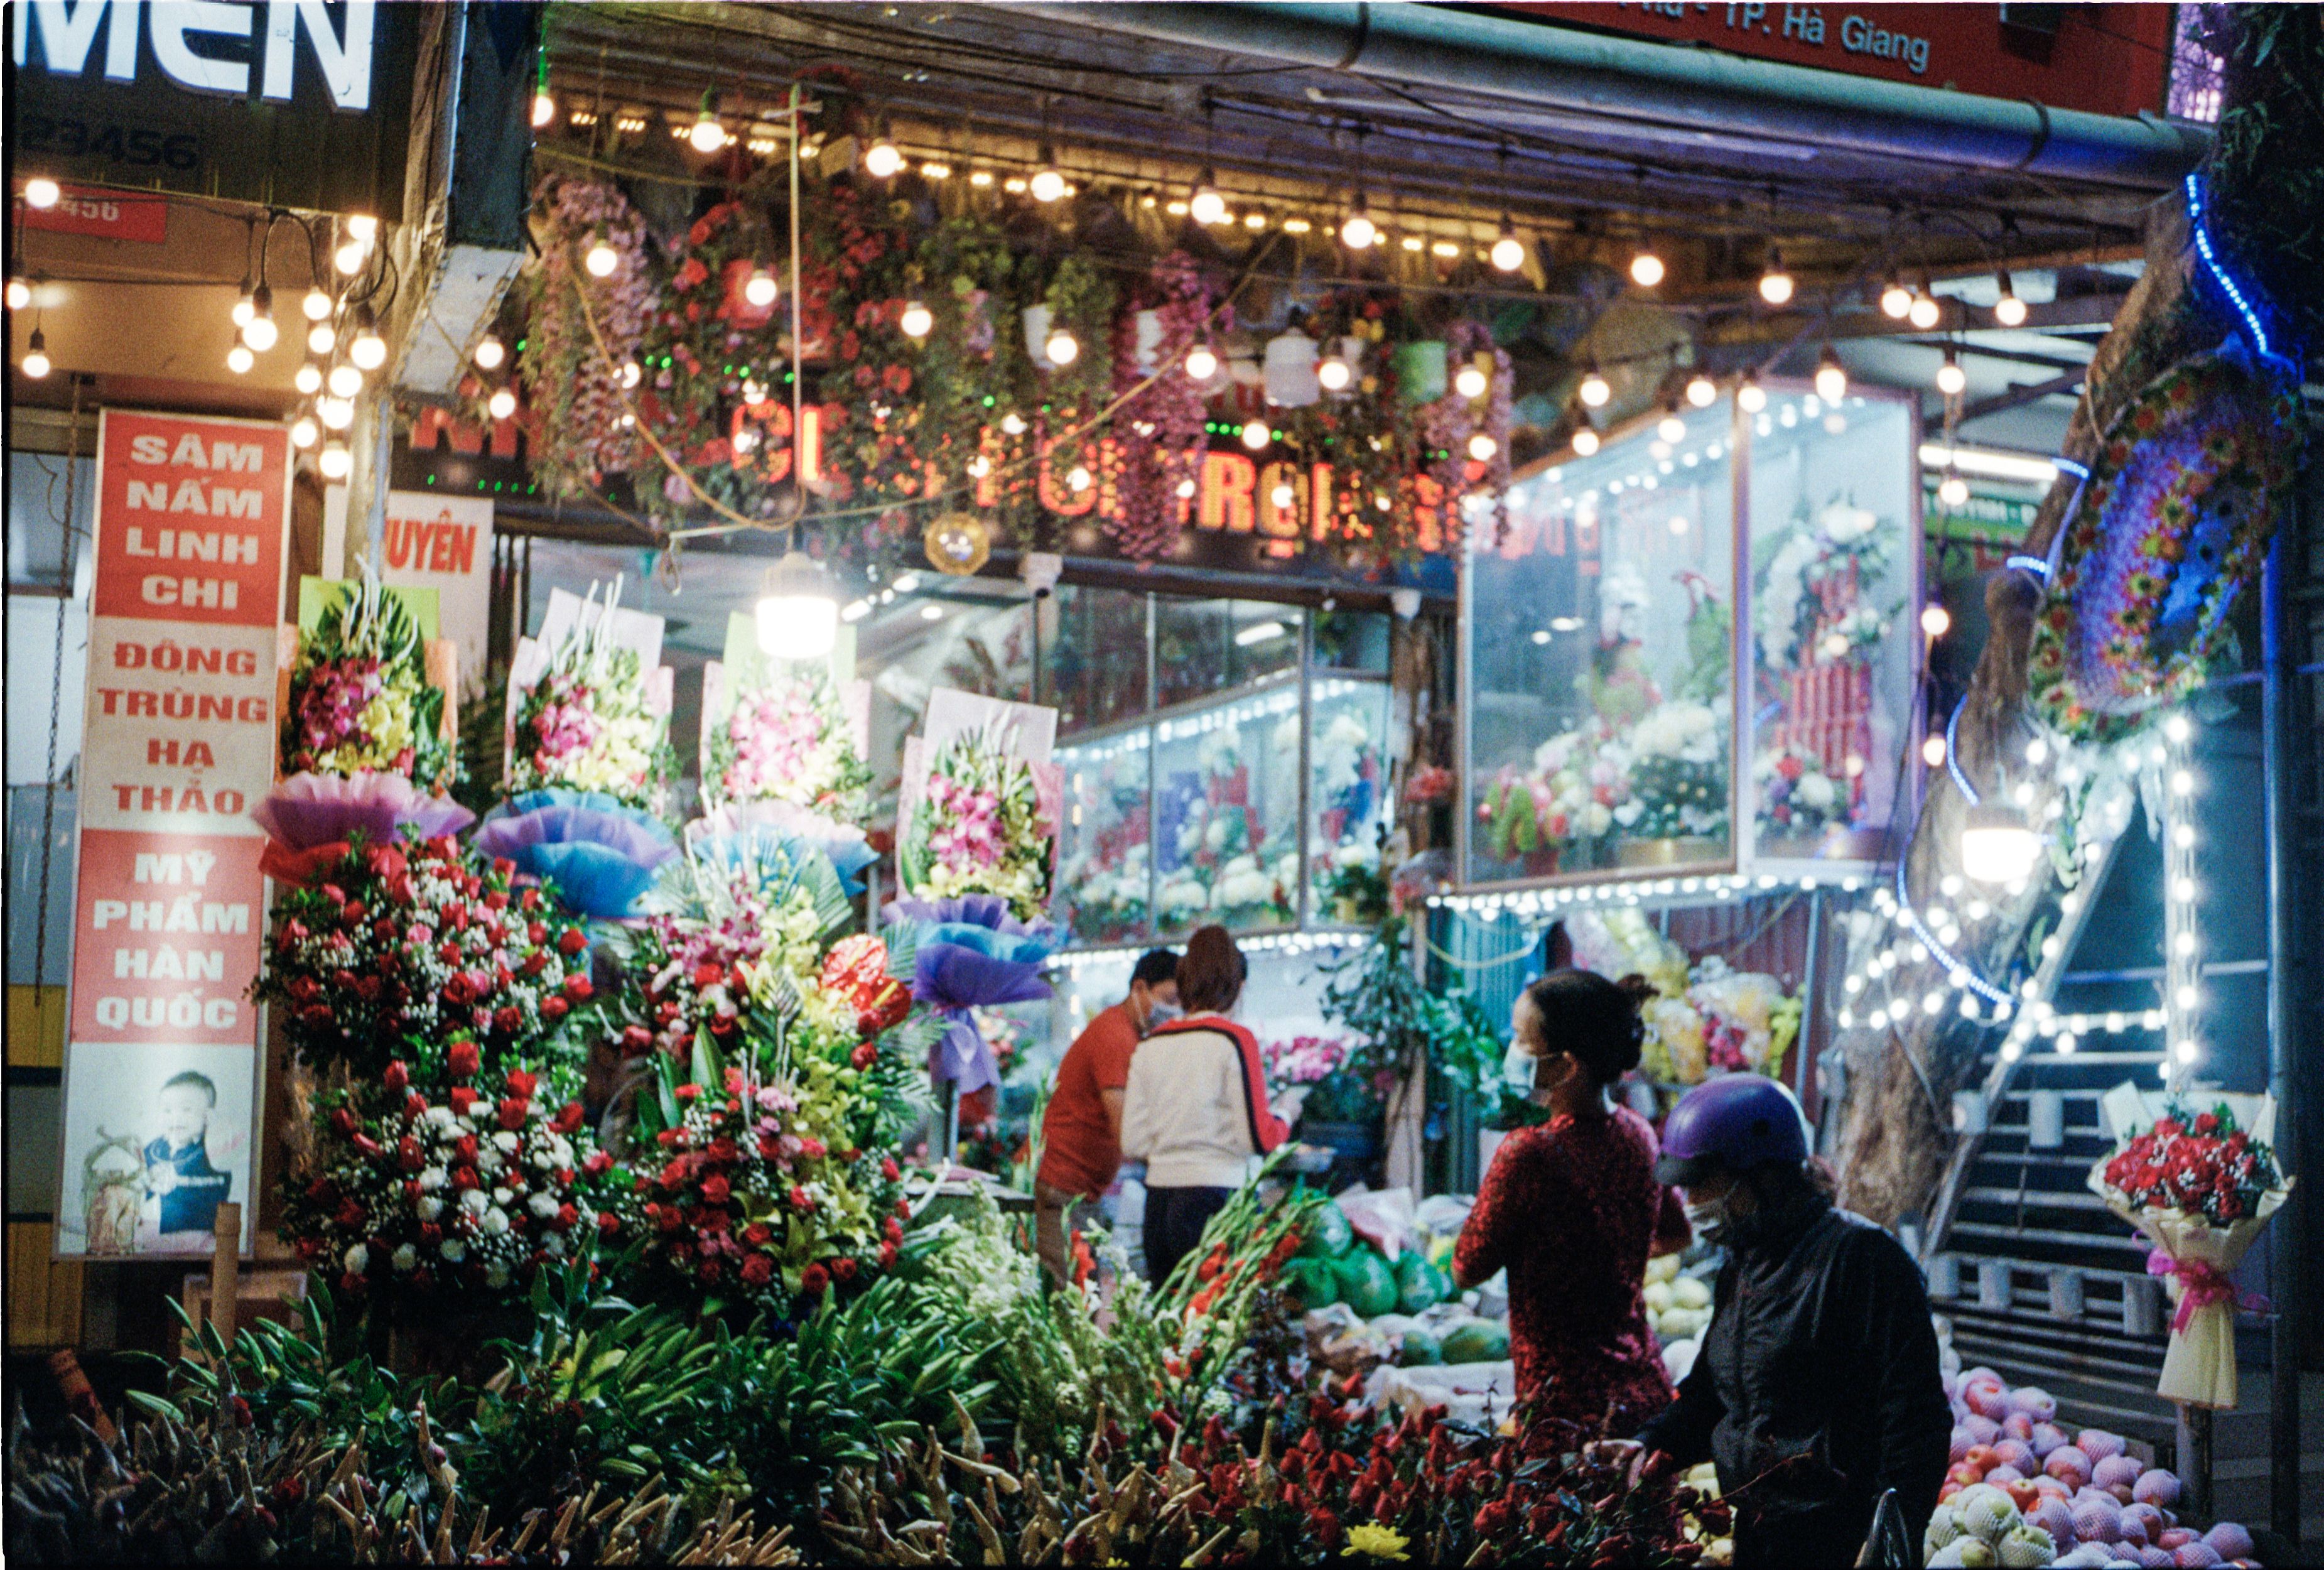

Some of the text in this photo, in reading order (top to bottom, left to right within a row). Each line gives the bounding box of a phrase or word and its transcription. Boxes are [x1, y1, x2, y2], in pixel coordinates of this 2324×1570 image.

[1726, 3, 1769, 33] TP.
[1783, 4, 1825, 44] Hà
[1840, 16, 1929, 74] Giang
[130, 433, 264, 473] SÂM
[127, 478, 263, 519] NẤM
[126, 526, 259, 564] LINH
[384, 509, 477, 574] UYÊN
[142, 575, 238, 610] CHI
[114, 638, 257, 676] ĐÔNG
[97, 686, 268, 723] TRÙNG
[146, 738, 215, 774] HẠ
[112, 777, 244, 815] THẢO
[135, 848, 216, 885] MỸ
[114, 944, 224, 982] HÀN
[95, 988, 236, 1030] QUỐC
